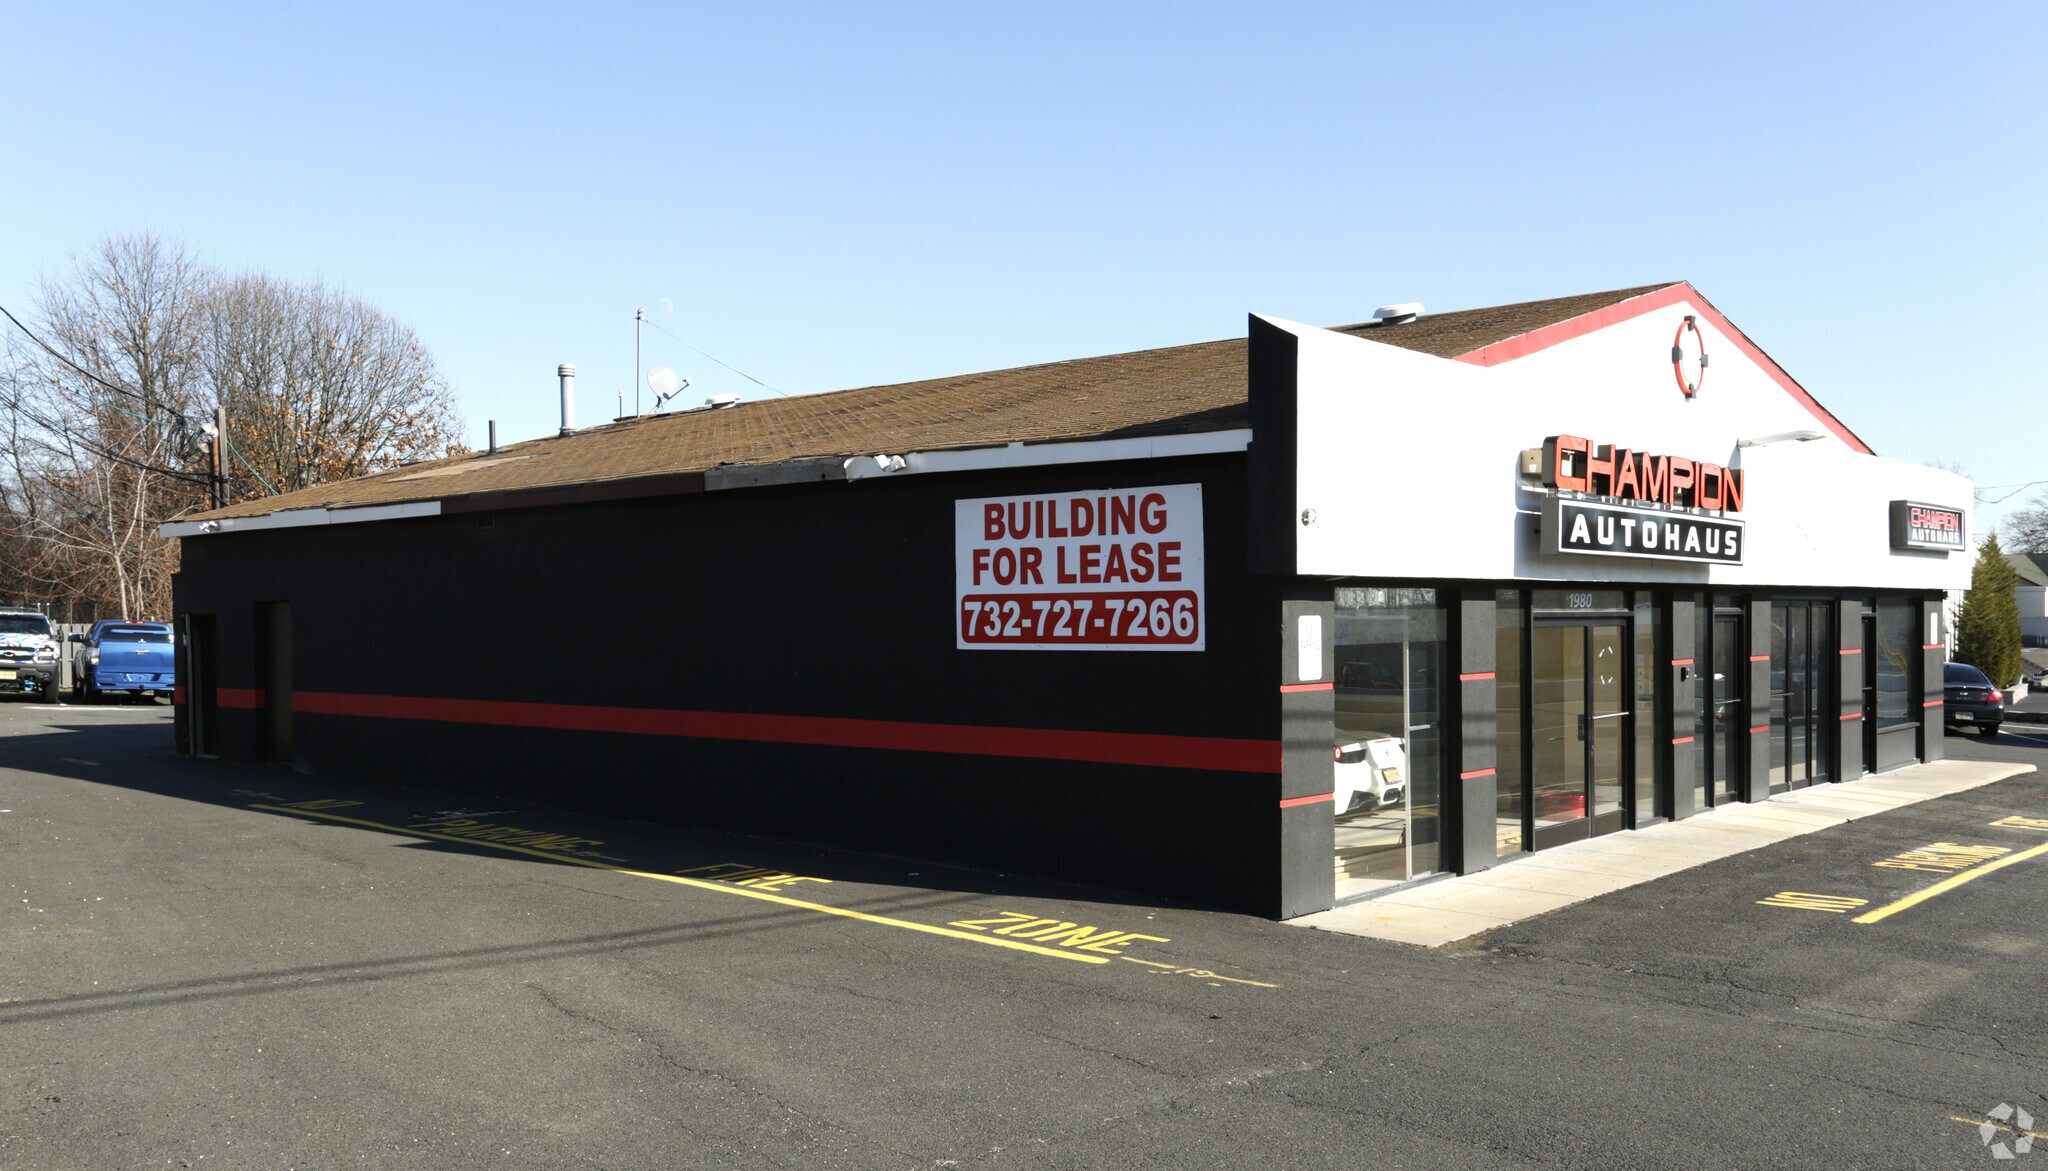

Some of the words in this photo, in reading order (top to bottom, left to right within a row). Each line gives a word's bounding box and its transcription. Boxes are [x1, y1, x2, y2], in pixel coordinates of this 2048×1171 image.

[1546, 434, 1744, 513] CHAMPION
[984, 493, 1167, 540] BUILDING
[1569, 513, 1738, 556] AUTOHAUS
[1911, 507, 1959, 532] CHAMPION
[1911, 528, 1960, 544] AUTOHAUS
[972, 547, 1044, 586] FOR
[1056, 541, 1182, 584] LEASE
[964, 597, 1195, 637] 732-727-7266
[1569, 593, 1593, 608] 1980
[407, 819, 605, 850] PARKING
[673, 862, 834, 892] FIRE
[946, 911, 1171, 954] ZONE
[1755, 891, 1869, 913] NO
